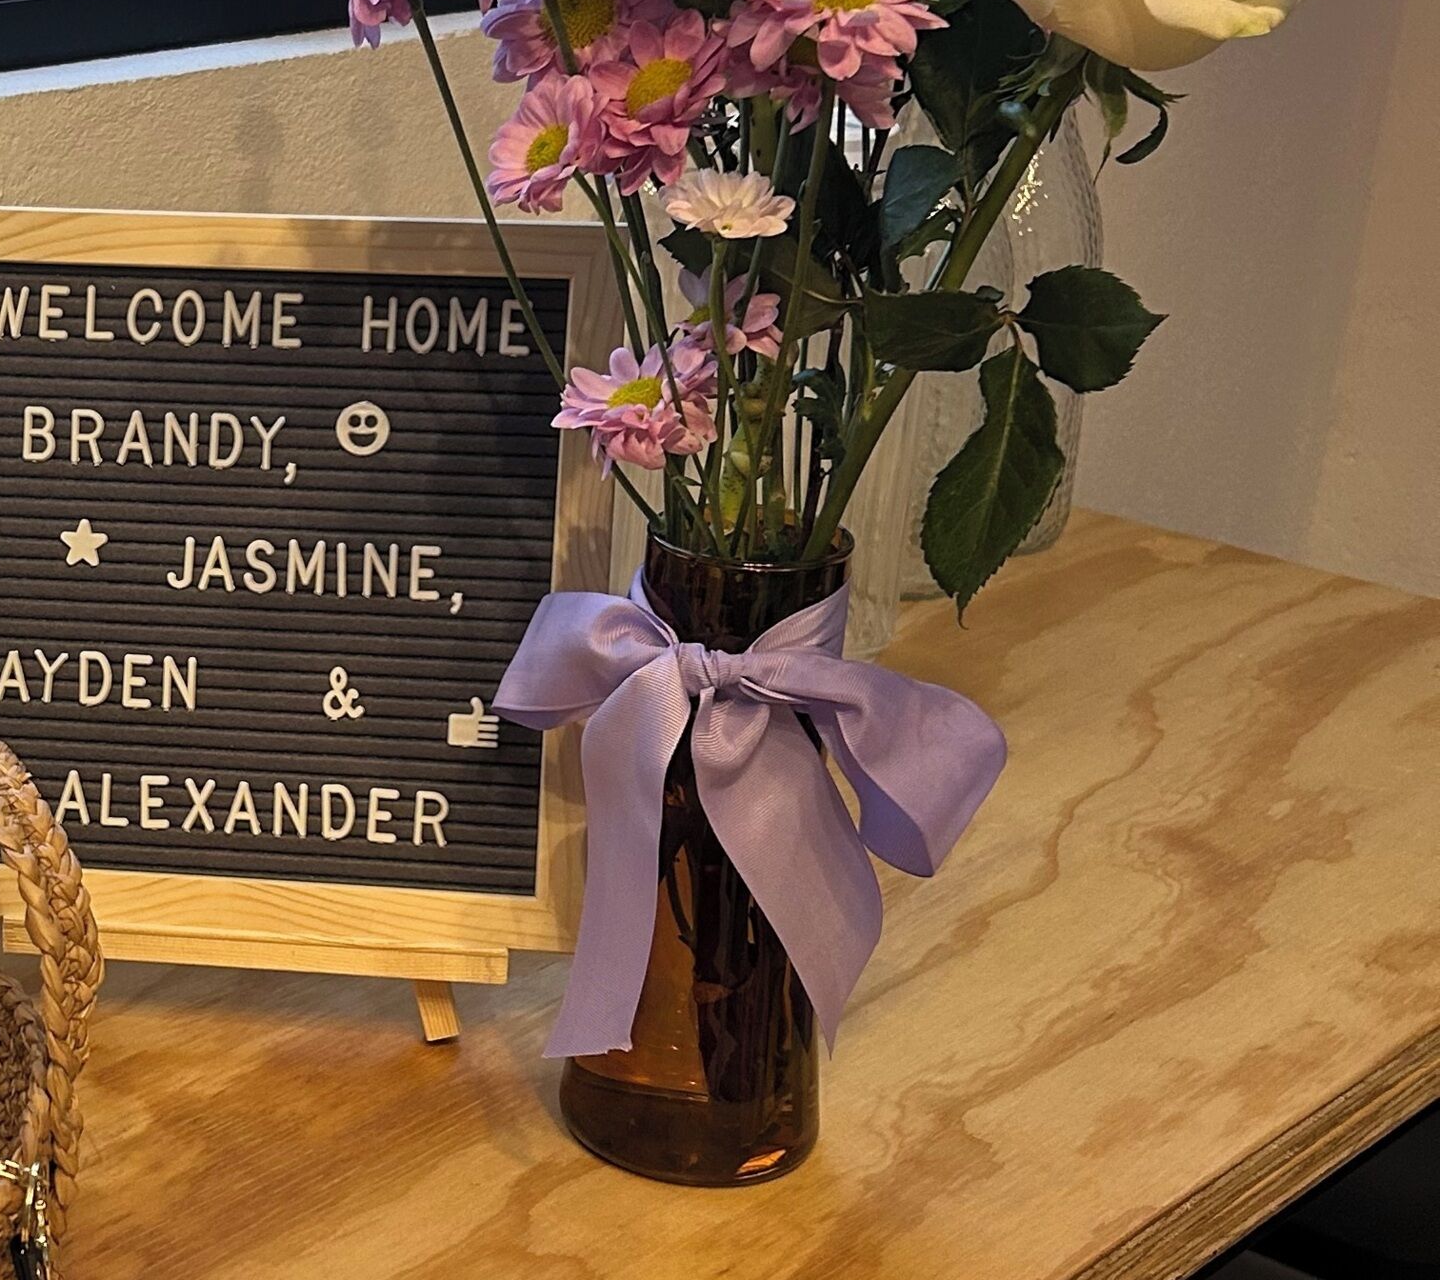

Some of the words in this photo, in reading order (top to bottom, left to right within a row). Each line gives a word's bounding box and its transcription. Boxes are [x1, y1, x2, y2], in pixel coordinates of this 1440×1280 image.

[363, 295, 533, 358] HOME
[21, 406, 298, 485] BRANDY,
[166, 535, 463, 615] JASMINE,
[322, 667, 364, 721] &
[54, 770, 449, 848] ALEXANDER
